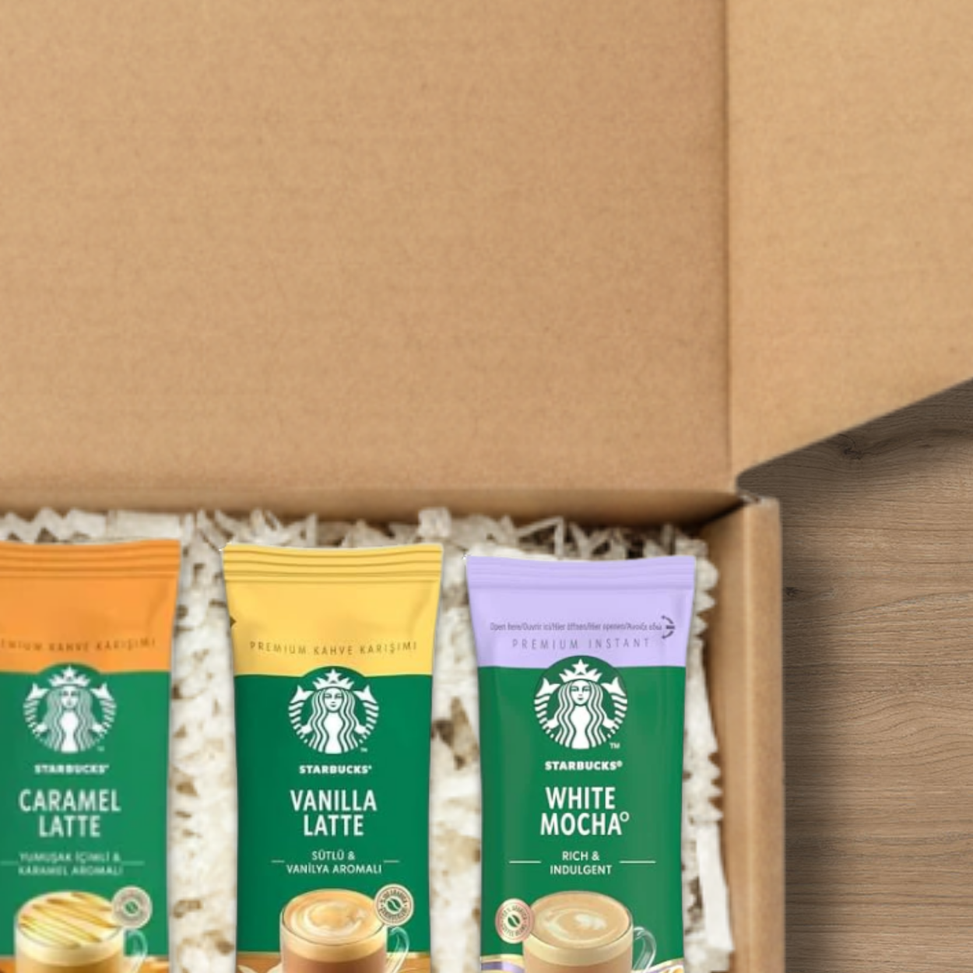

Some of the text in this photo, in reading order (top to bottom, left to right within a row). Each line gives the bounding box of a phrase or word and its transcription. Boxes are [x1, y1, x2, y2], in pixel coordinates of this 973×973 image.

[249, 640, 307, 655] PREMIUM
[313, 645, 353, 656] KAHVE
[512, 637, 650, 650] PREMIUM INSTANT
[299, 765, 369, 774] STARBUCKS
[18, 788, 122, 812] CARAMEL
[289, 788, 378, 812] VANILLA
[545, 786, 616, 810] WHITE
[38, 814, 102, 838] LATTE
[303, 814, 365, 837] LATTE
[311, 849, 356, 861] SÜTLÜ &
[562, 851, 600, 861] RICH &
[286, 862, 382, 874] VANİLYA AROMALI
[550, 865, 613, 875] INDULGENT
